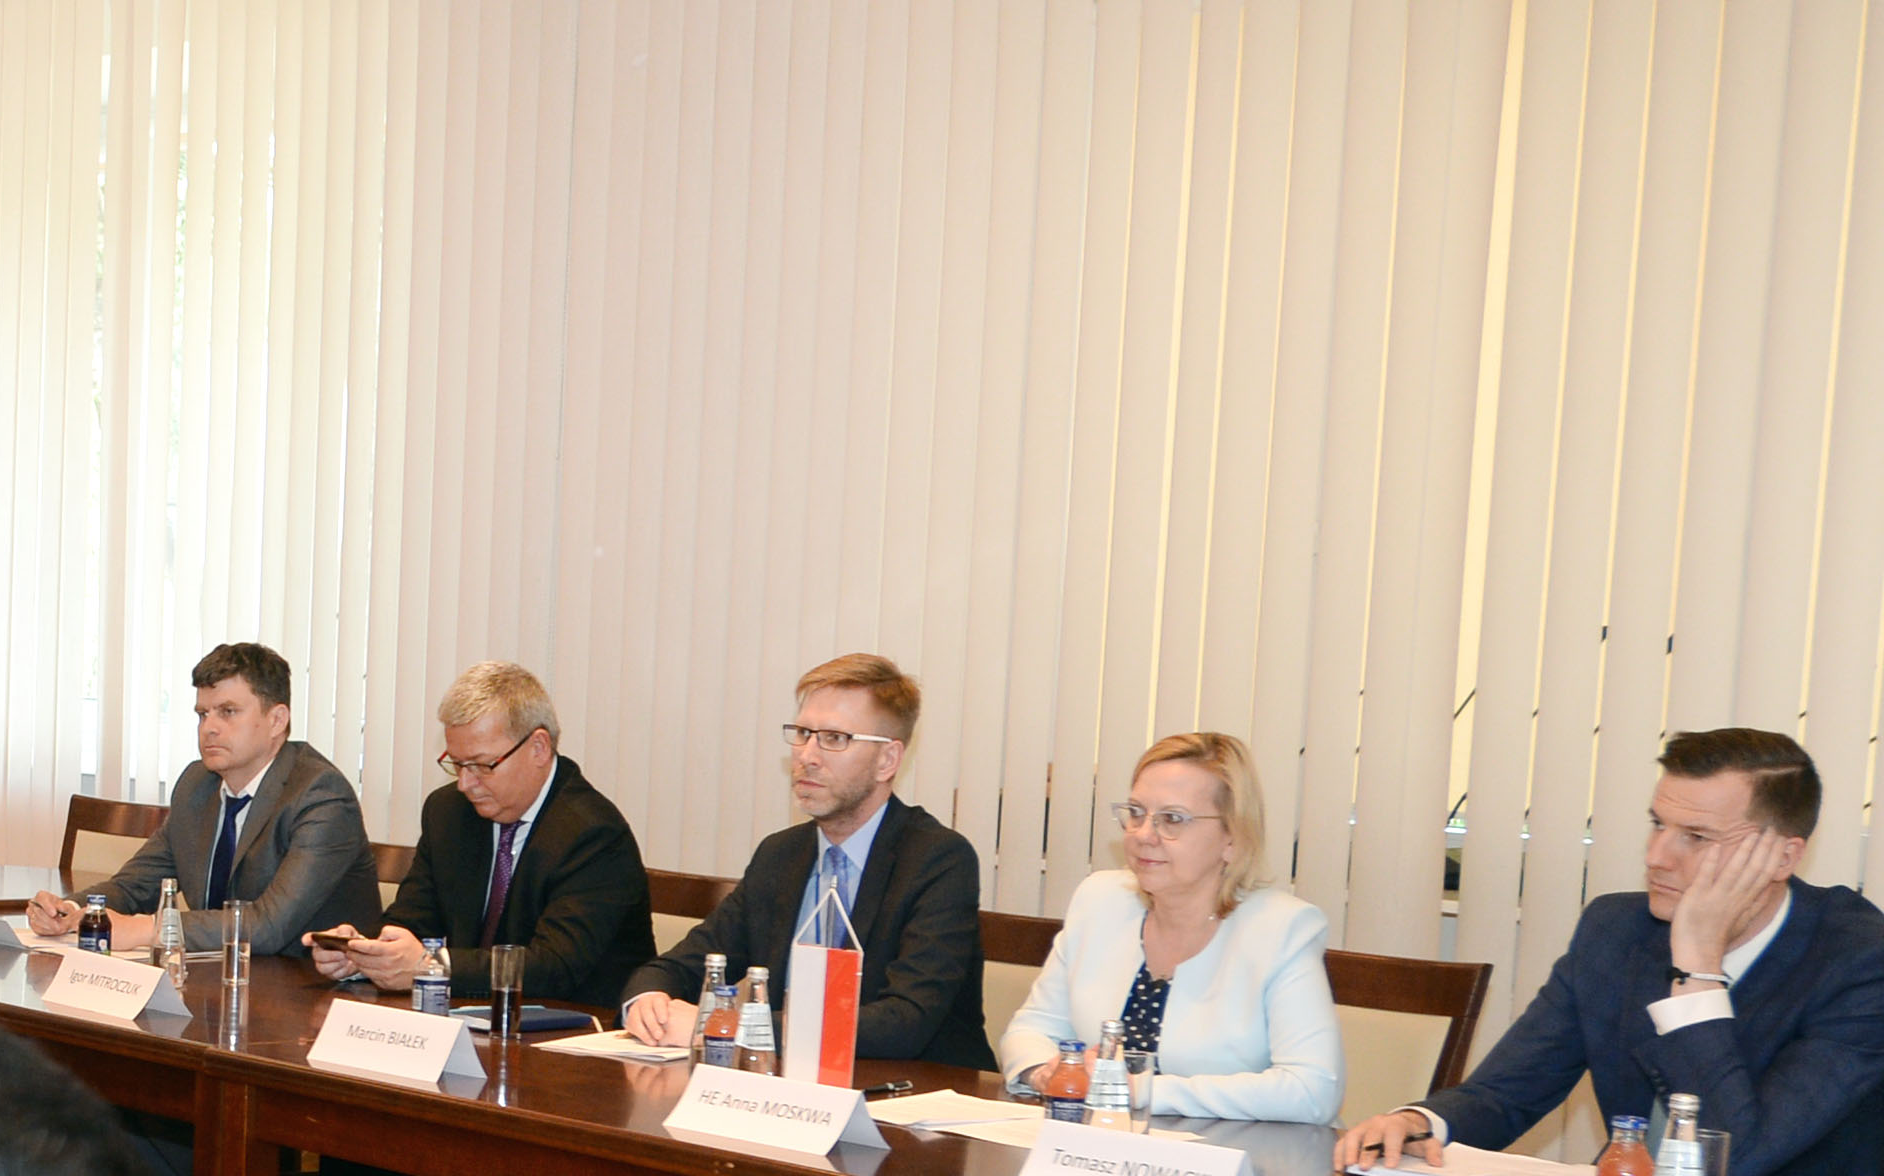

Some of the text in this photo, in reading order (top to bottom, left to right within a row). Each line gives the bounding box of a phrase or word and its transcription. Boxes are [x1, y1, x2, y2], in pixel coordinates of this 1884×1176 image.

[347, 1024, 385, 1041] Marcin
[699, 1090, 833, 1126] HE Anna MOSKWA
[1052, 1148, 1116, 1174] Tomasz
